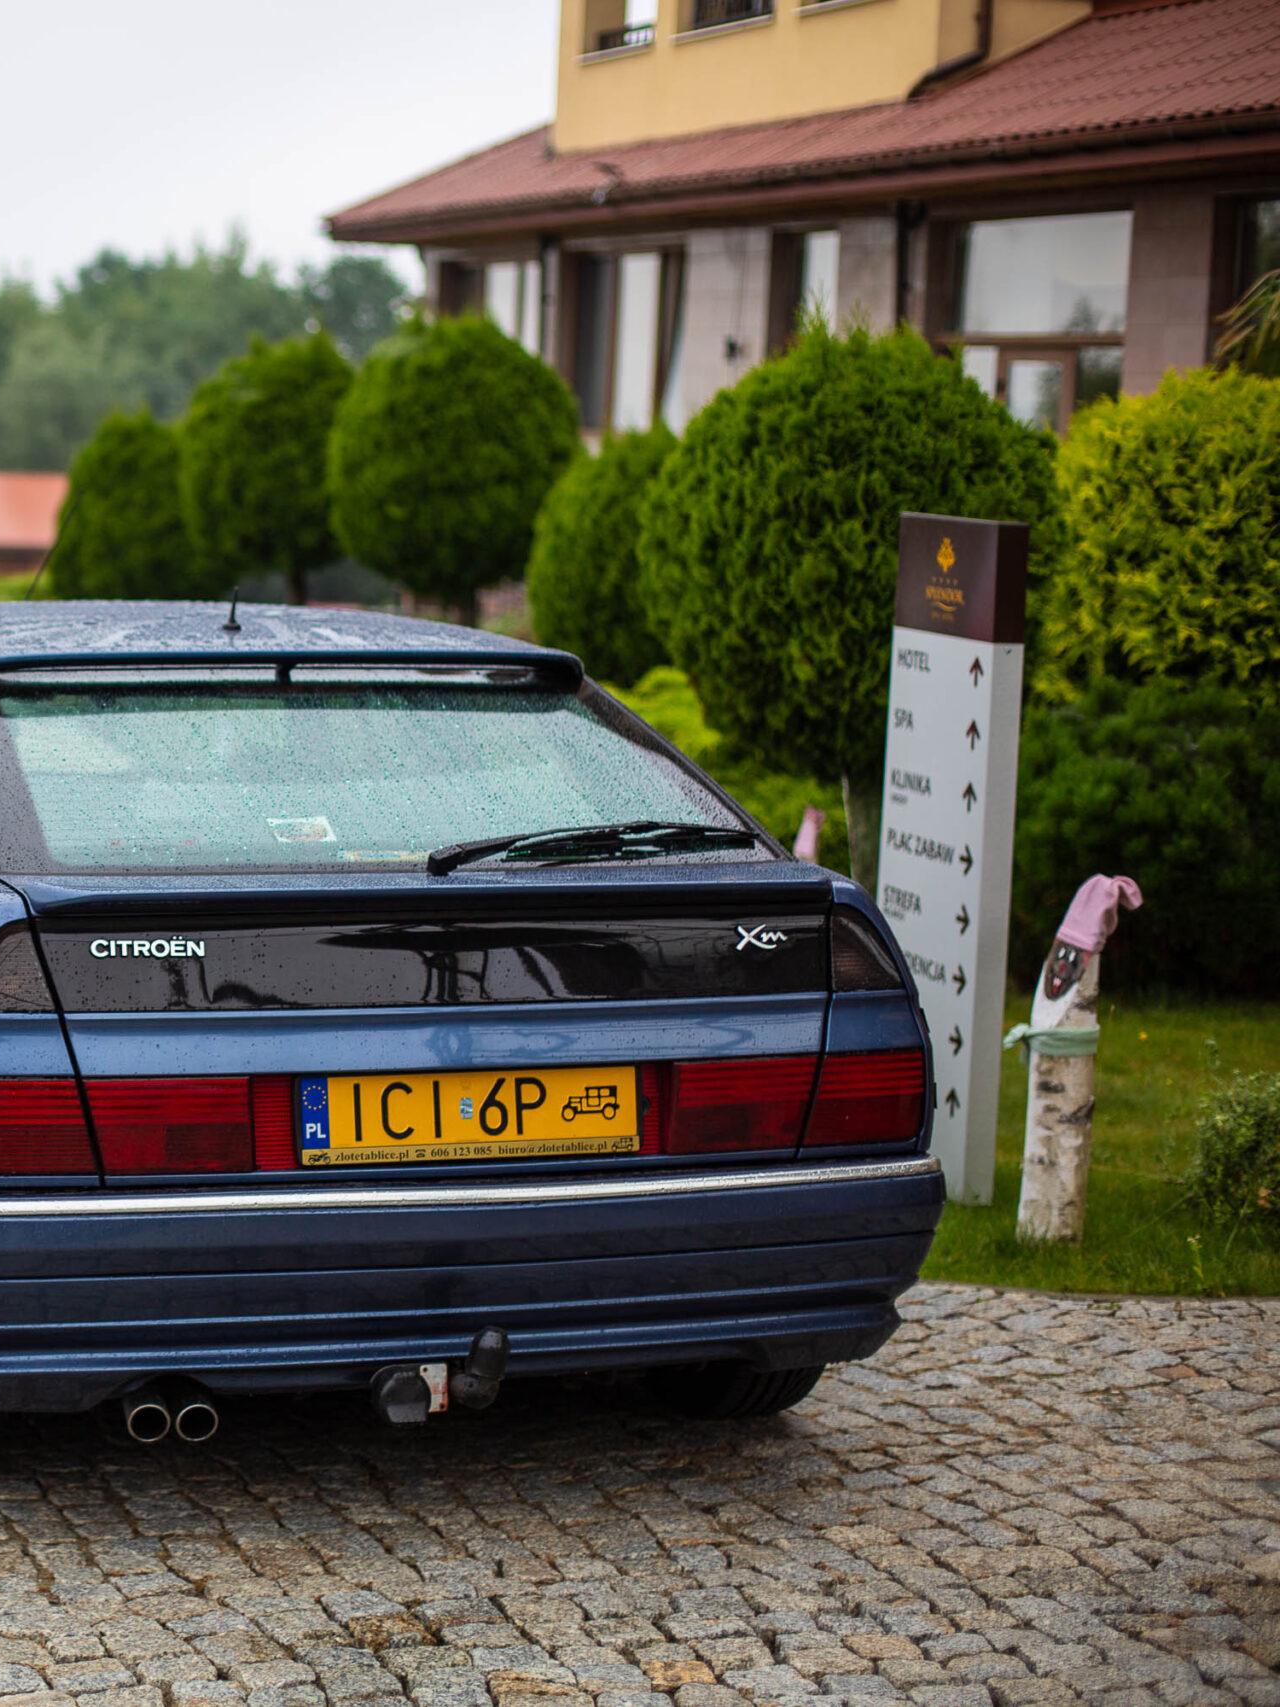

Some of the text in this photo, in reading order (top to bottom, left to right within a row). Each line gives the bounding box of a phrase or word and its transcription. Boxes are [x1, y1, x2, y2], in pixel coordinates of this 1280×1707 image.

[897, 649, 931, 673] HOTEL
[894, 708, 914, 731] SPA
[891, 768, 932, 796] KLINIKA
[887, 827, 955, 866] PLAC ZABAW
[883, 884, 922, 915] STREFA
[90, 935, 206, 958] CITROËN
[479, 1077, 547, 1137] 6P
[305, 1122, 326, 1139] PL
[335, 1149, 409, 1162] zlotetablice.pl
[431, 1147, 450, 1158] 606
[453, 1146, 471, 1157] 123
[473, 1144, 493, 1156] 085
